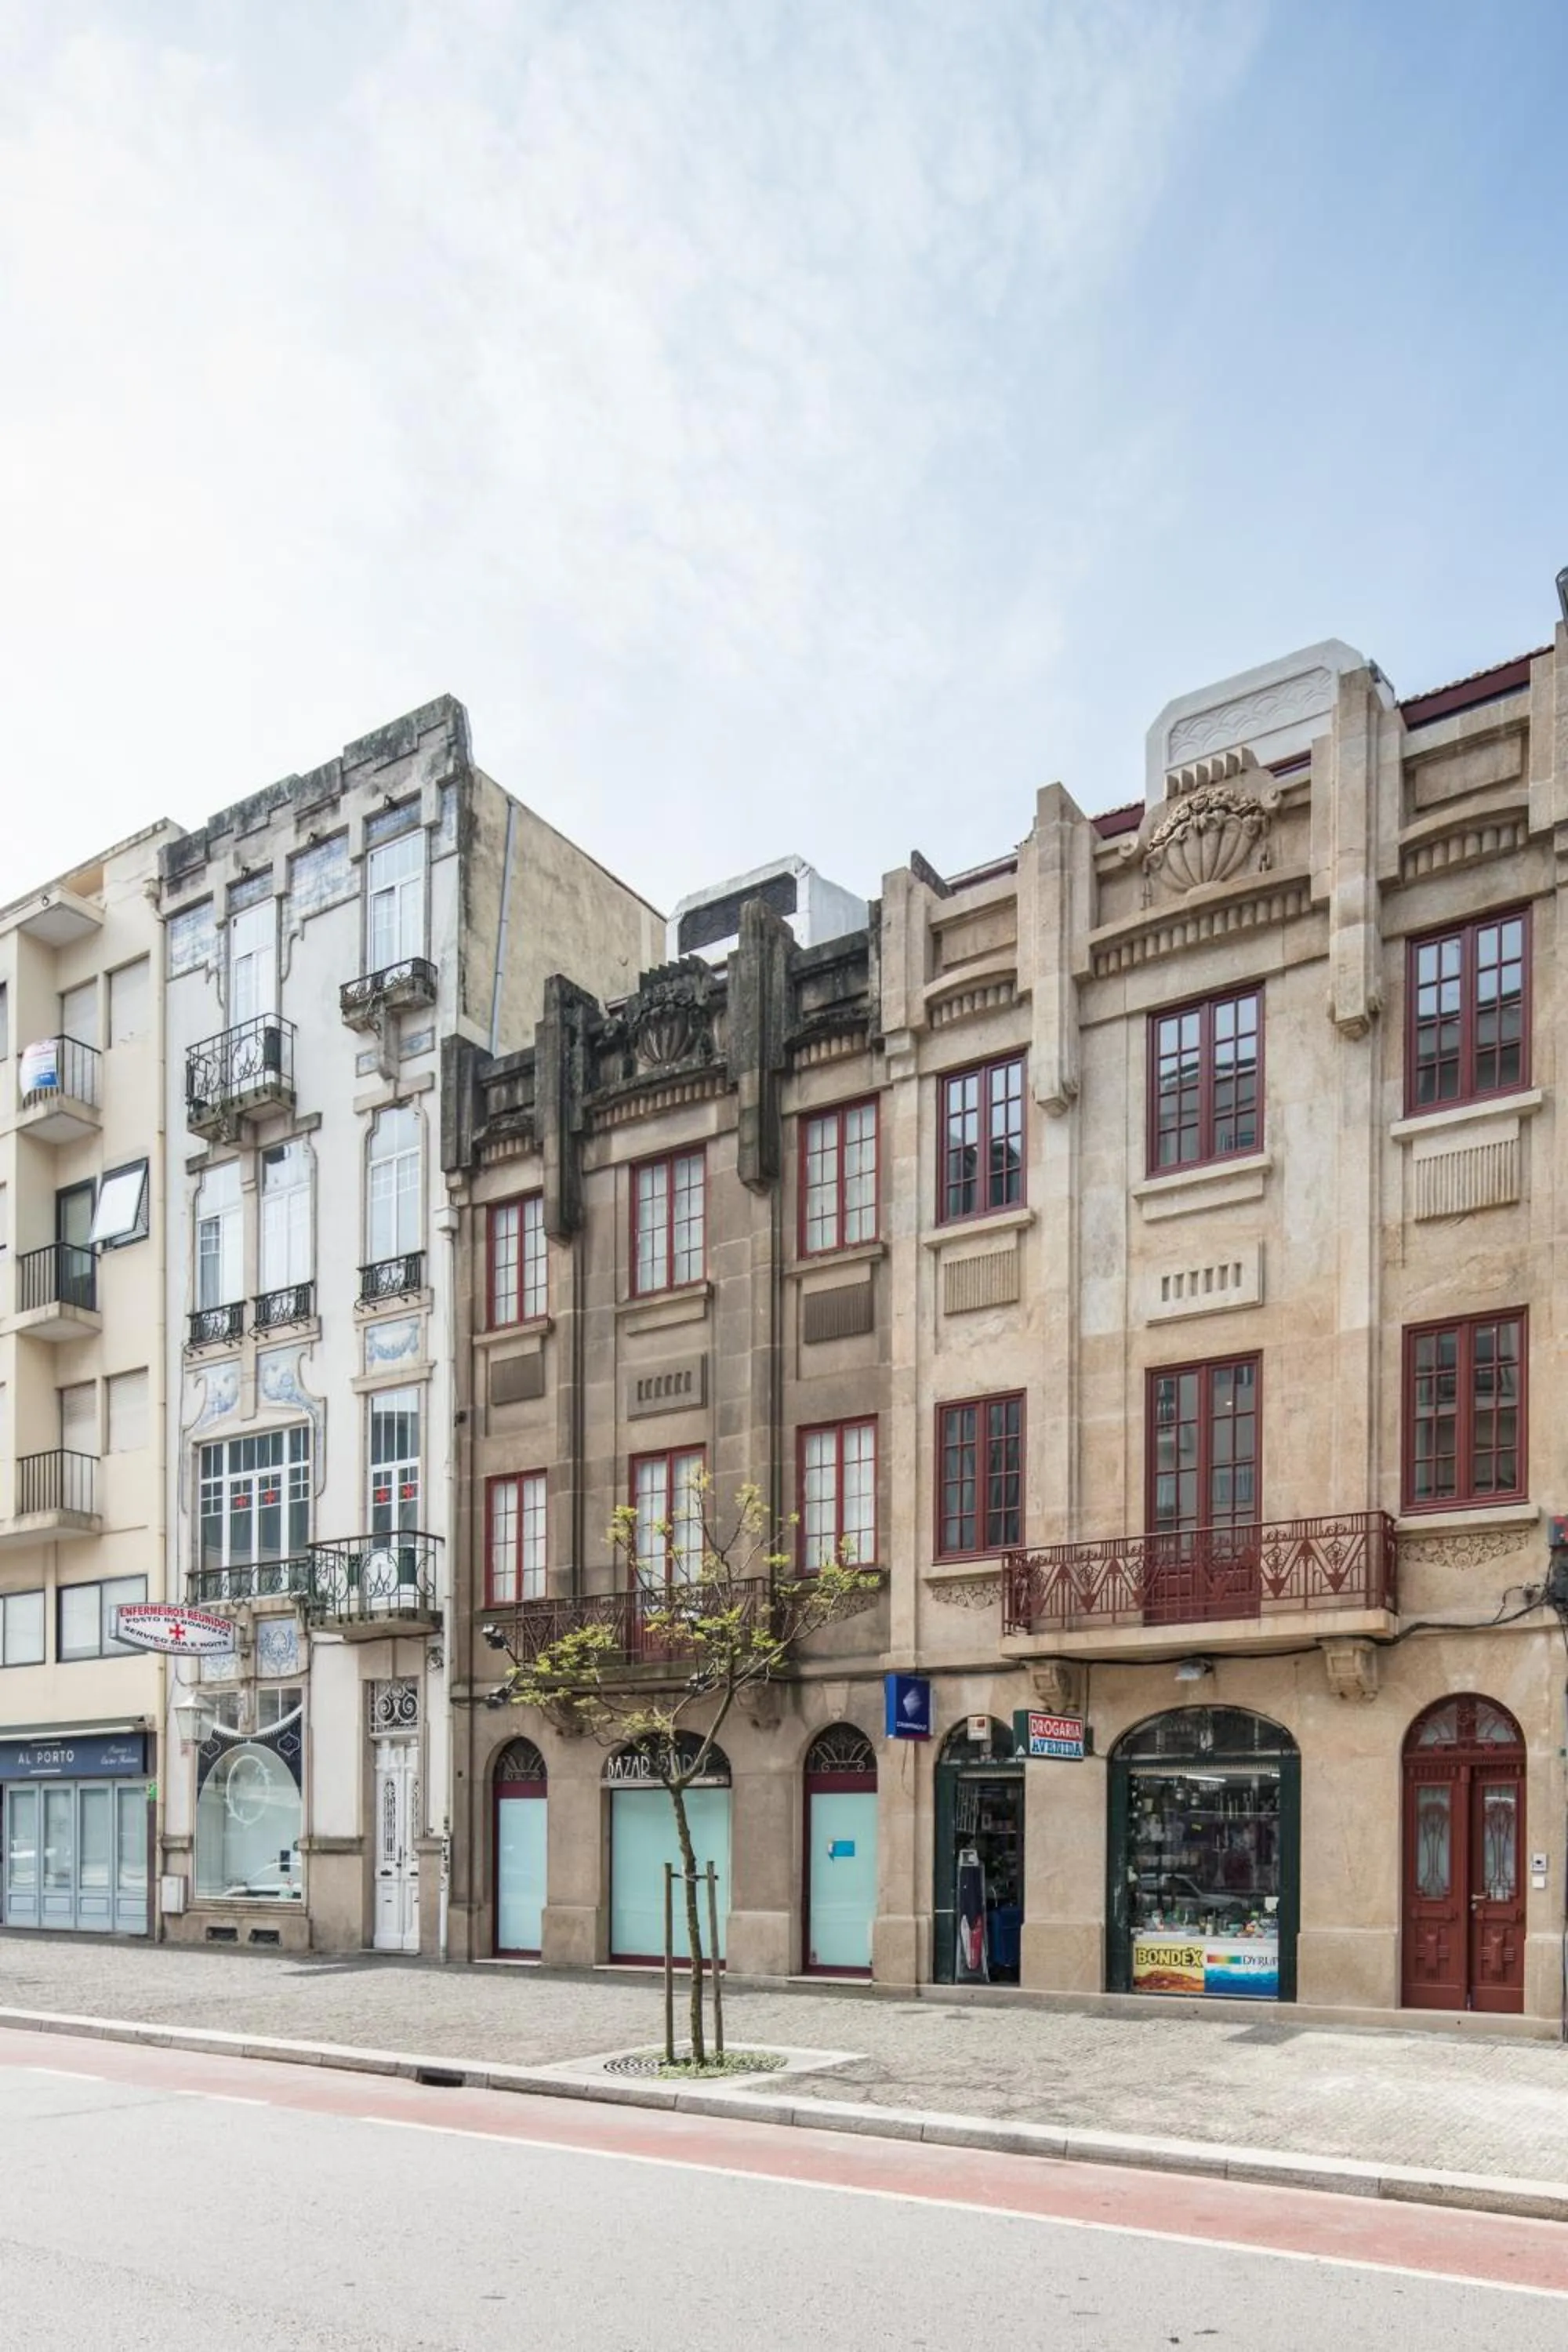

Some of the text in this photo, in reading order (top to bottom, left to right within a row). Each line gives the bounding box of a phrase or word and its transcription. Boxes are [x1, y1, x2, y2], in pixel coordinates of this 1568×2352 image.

[120, 1606, 231, 1632] ENFERMEIROS REUNIDOS
[181, 1619, 229, 1637] BOAVISTA
[1031, 1719, 1080, 1738] DROGARIA
[1032, 1738, 1082, 1756] AVENIDA
[18, 1749, 74, 1765] AL PORTO
[608, 1753, 712, 1780] BAZAR PARS
[1136, 1947, 1203, 1968] BONDEX
